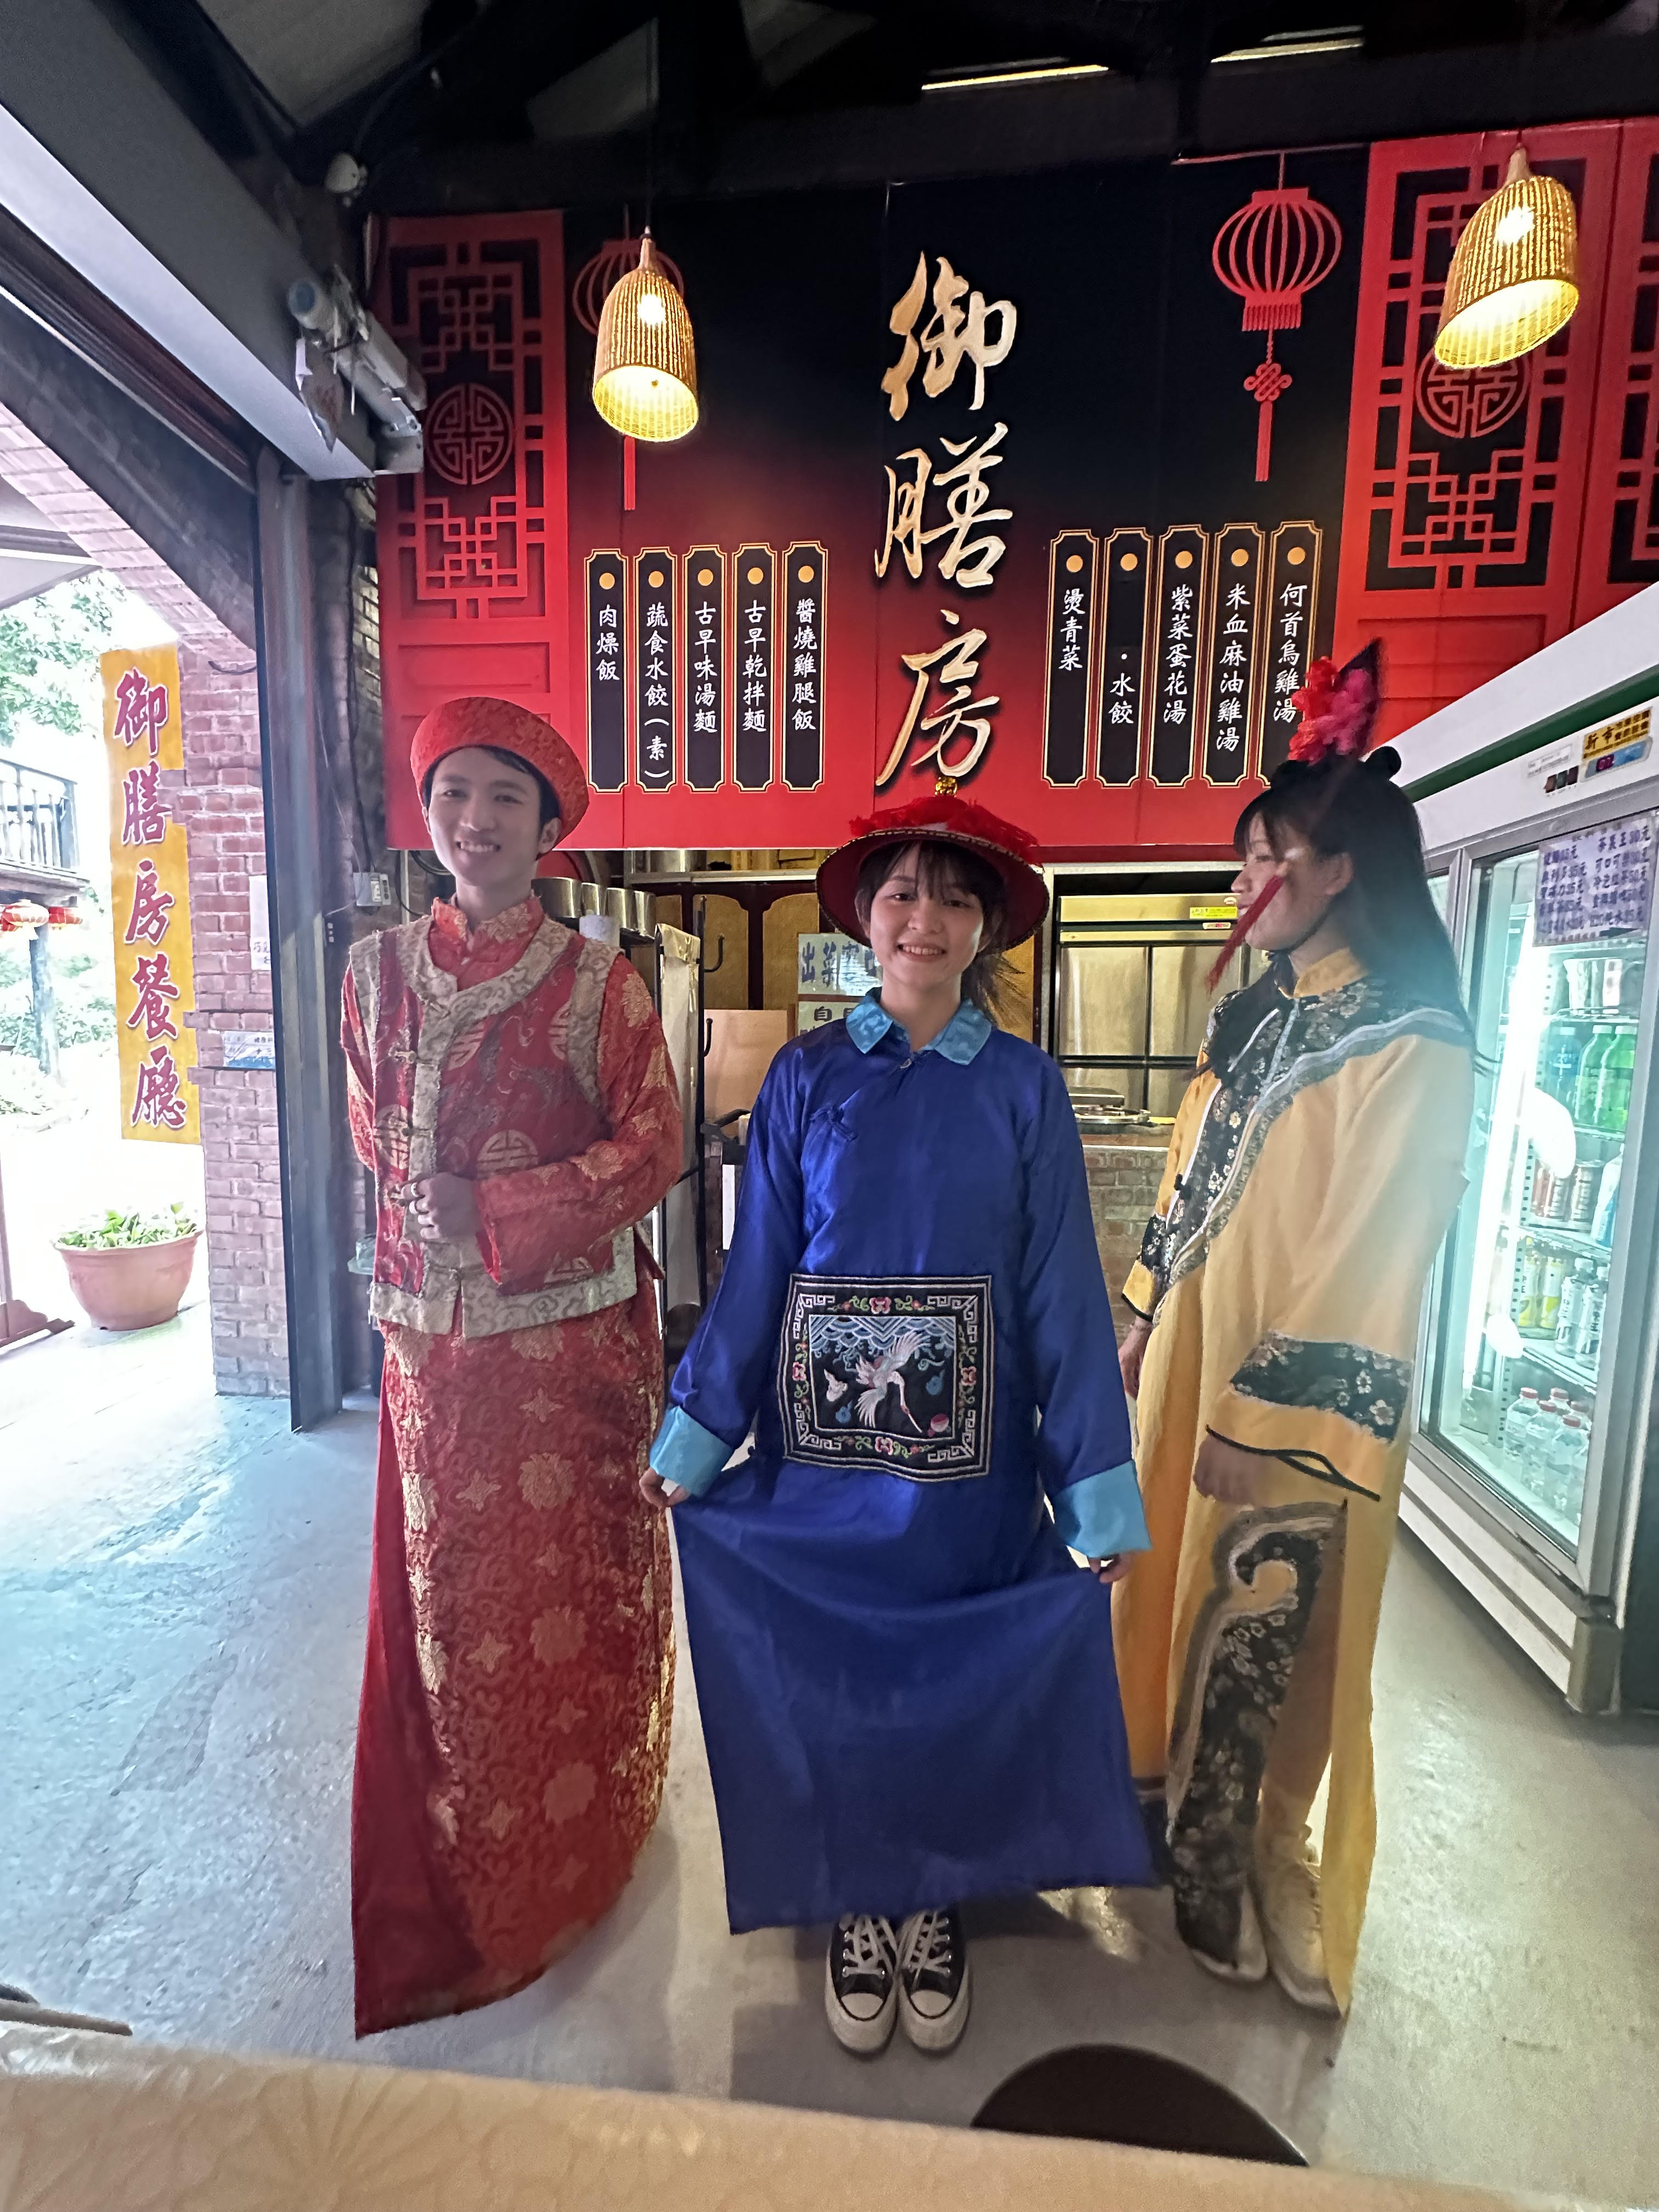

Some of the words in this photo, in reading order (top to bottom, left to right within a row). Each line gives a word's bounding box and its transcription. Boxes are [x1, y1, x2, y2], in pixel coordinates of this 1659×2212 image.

[873, 250, 1018, 787] 御膳房
[595, 604, 620, 681] 肉燥飯
[693, 601, 718, 733] 古早味湯麵
[742, 600, 767, 732] 古早乾拌麵
[792, 597, 817, 730] 醬燒雞腿飯
[1058, 588, 1086, 672] 燙青菜
[1163, 583, 1194, 725] 紫菜蛋花湯
[1216, 583, 1251, 752] 米血麻油雞湯
[1273, 583, 1308, 723] 何首烏雞湯
[114, 668, 188, 1130] 御膳房餐廳
